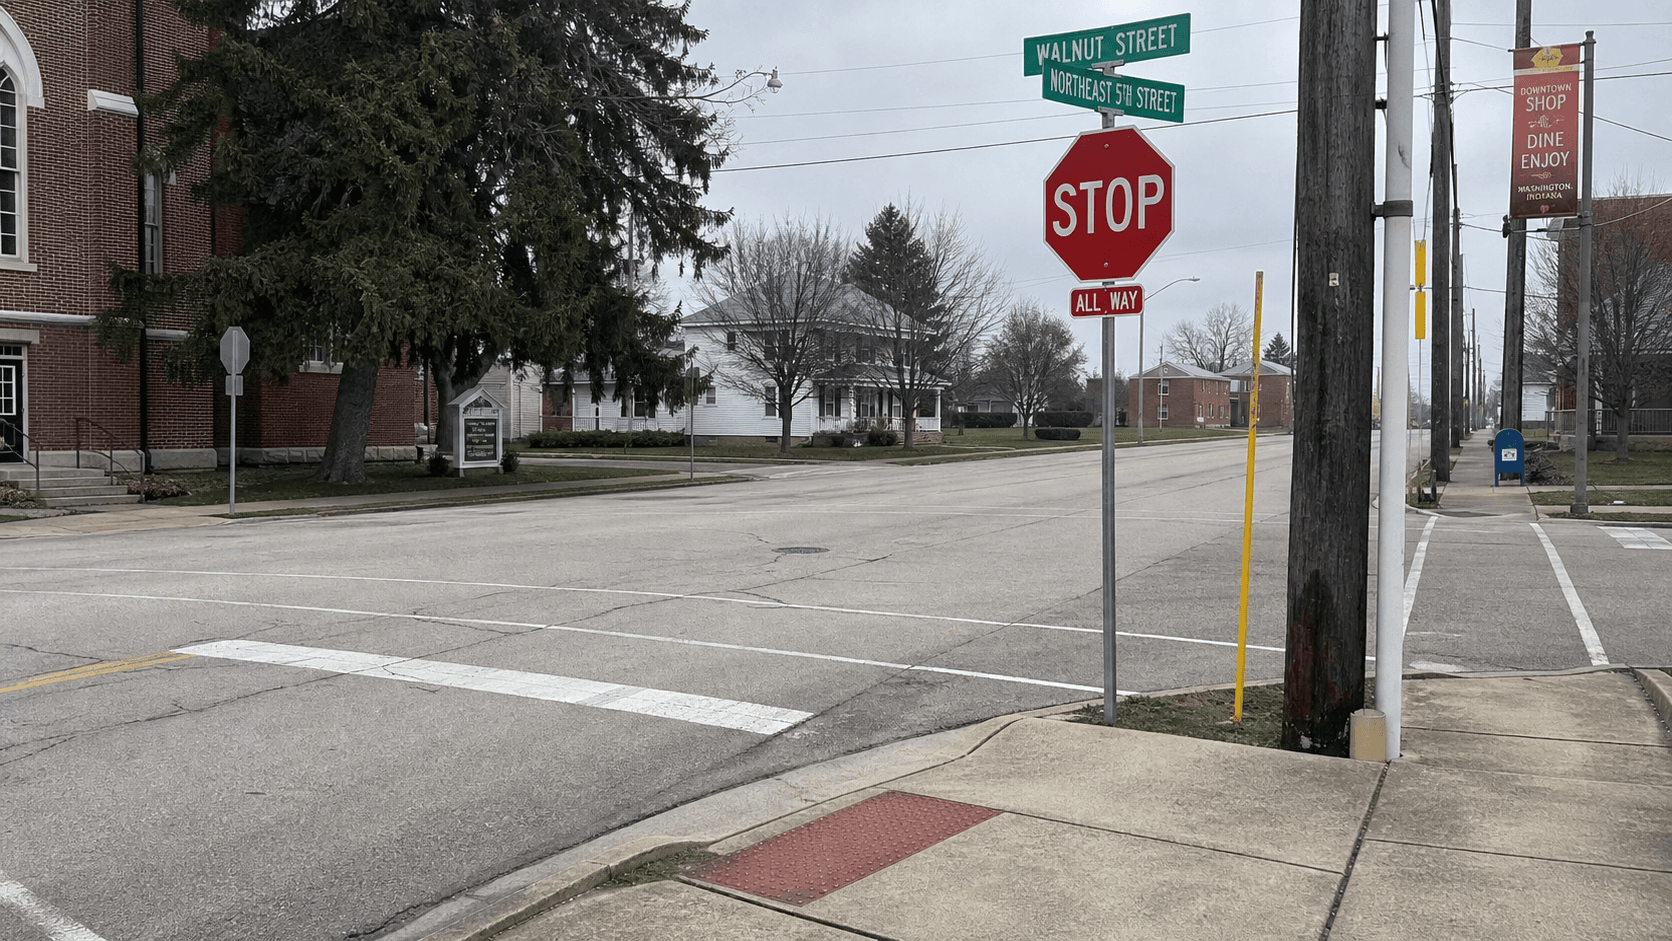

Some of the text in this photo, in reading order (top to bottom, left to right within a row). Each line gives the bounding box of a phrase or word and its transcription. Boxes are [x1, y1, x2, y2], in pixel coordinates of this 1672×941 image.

[1036, 23, 1178, 66] WALNUT STREET
[1050, 68, 1177, 113] NORTHEAST 5TH STREET
[1520, 83, 1572, 96] DOWNTOWN
[1526, 94, 1566, 112] SHOP
[1527, 131, 1564, 149] DINE
[1521, 151, 1570, 169] ENJOY
[1526, 191, 1563, 201] INDIANA
[1052, 174, 1165, 237] STOP
[1075, 290, 1138, 312] ALL WAY
